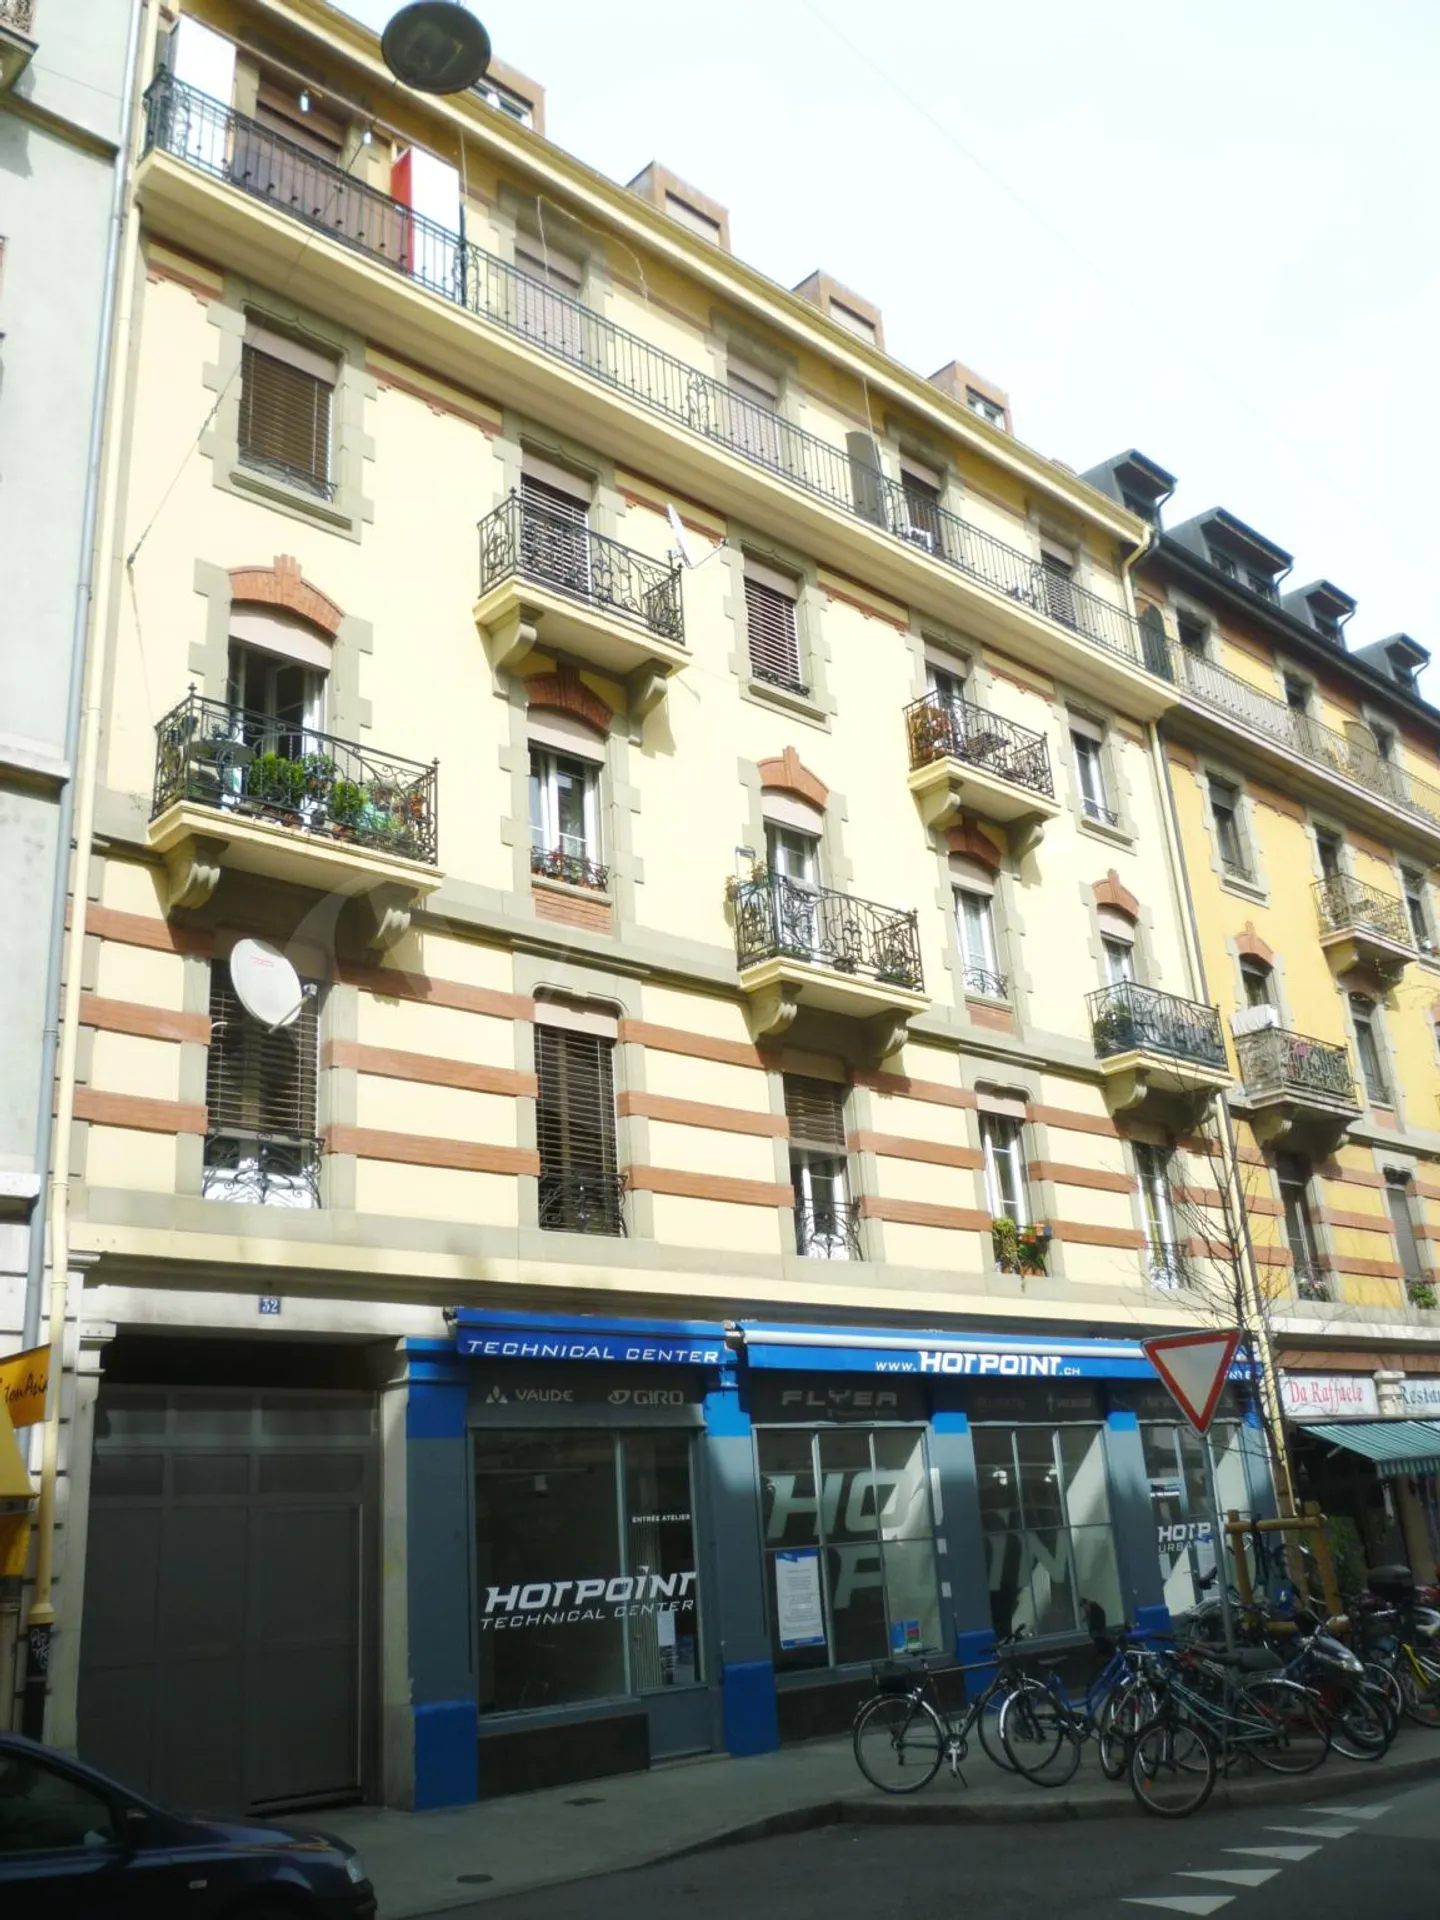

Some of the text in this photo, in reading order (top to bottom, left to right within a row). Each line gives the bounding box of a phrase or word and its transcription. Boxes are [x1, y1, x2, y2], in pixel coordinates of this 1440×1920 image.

[467, 1339, 720, 1363] TECHNICAL CENTER
[515, 1388, 574, 1402] VAUDE
[632, 1389, 685, 1405] GIRO
[780, 1388, 899, 1406] FLYER
[1288, 1380, 1307, 1403] Da
[662, 1513, 691, 1522] ATELIER
[484, 1565, 698, 1614] HOTPOINT
[480, 1599, 695, 1631] TECHNICAL CENTER
